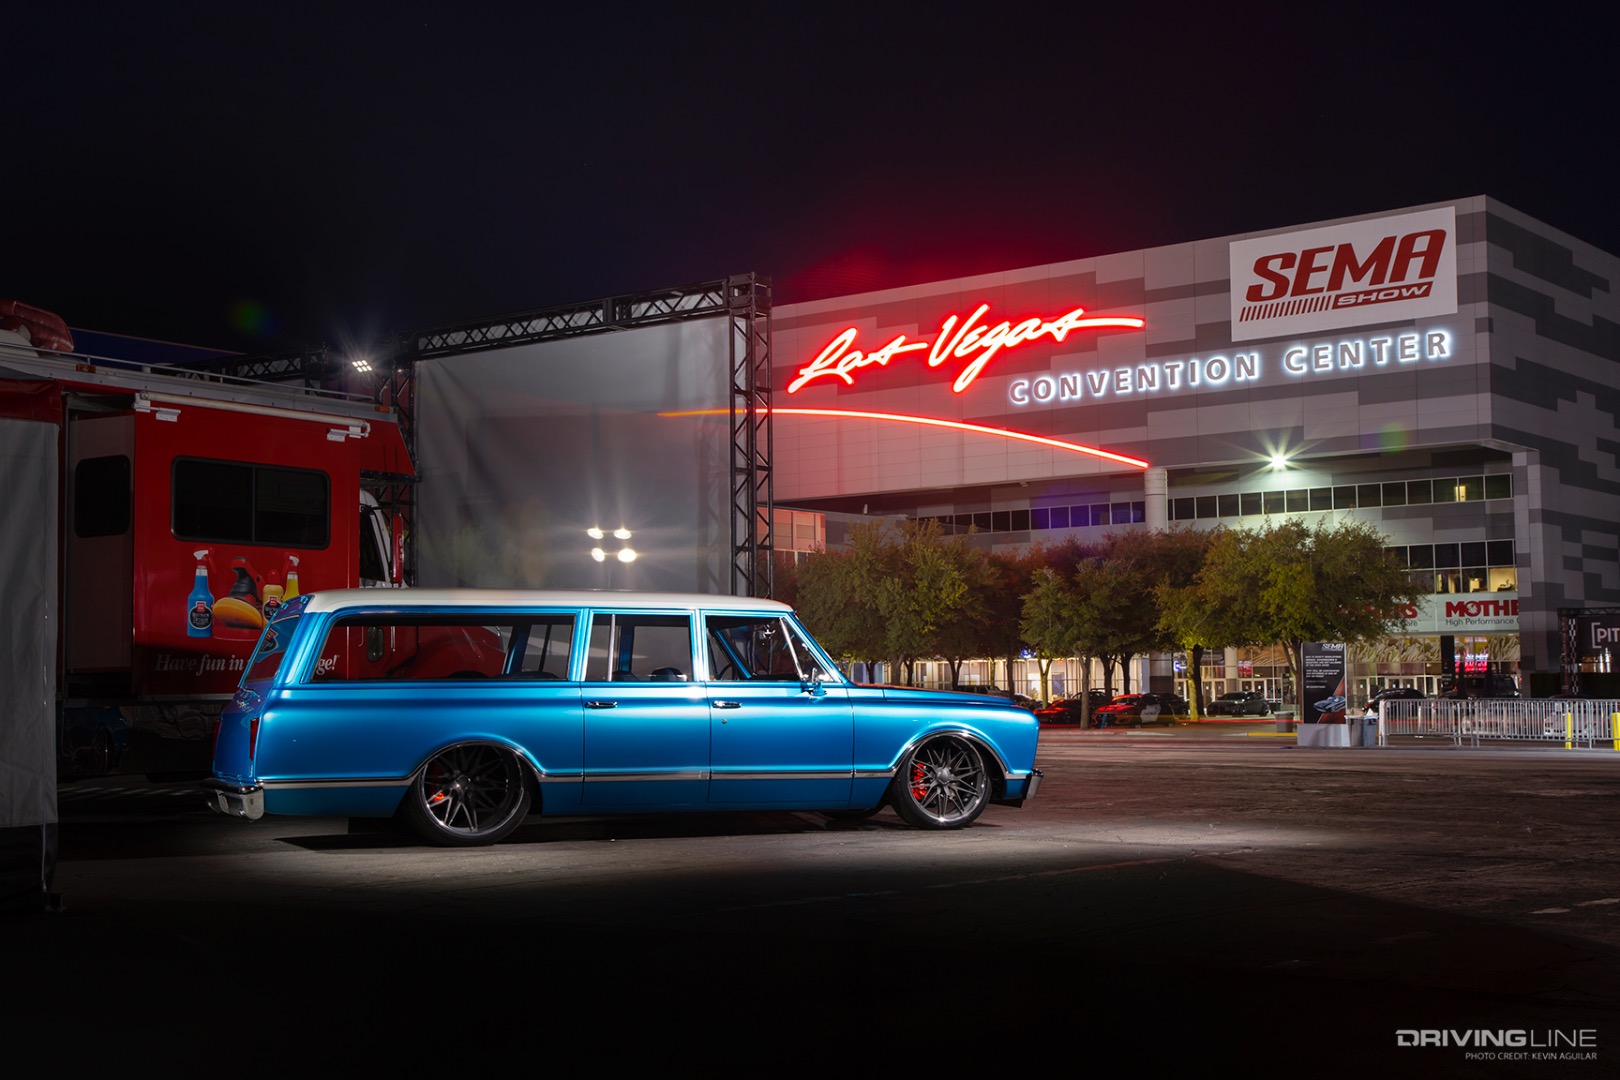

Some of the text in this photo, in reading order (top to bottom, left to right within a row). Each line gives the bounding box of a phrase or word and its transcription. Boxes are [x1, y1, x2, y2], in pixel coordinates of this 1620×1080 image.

[1245, 229, 1446, 303] SEMA
[1337, 284, 1429, 306] SHOW
[787, 303, 1144, 394] Las Vegas
[1008, 329, 1453, 405] CONVENTION CENTER
[1446, 617, 1515, 627] High Performance
[155, 653, 196, 672] Have
[195, 653, 226, 676] fun
[228, 654, 245, 672] in
